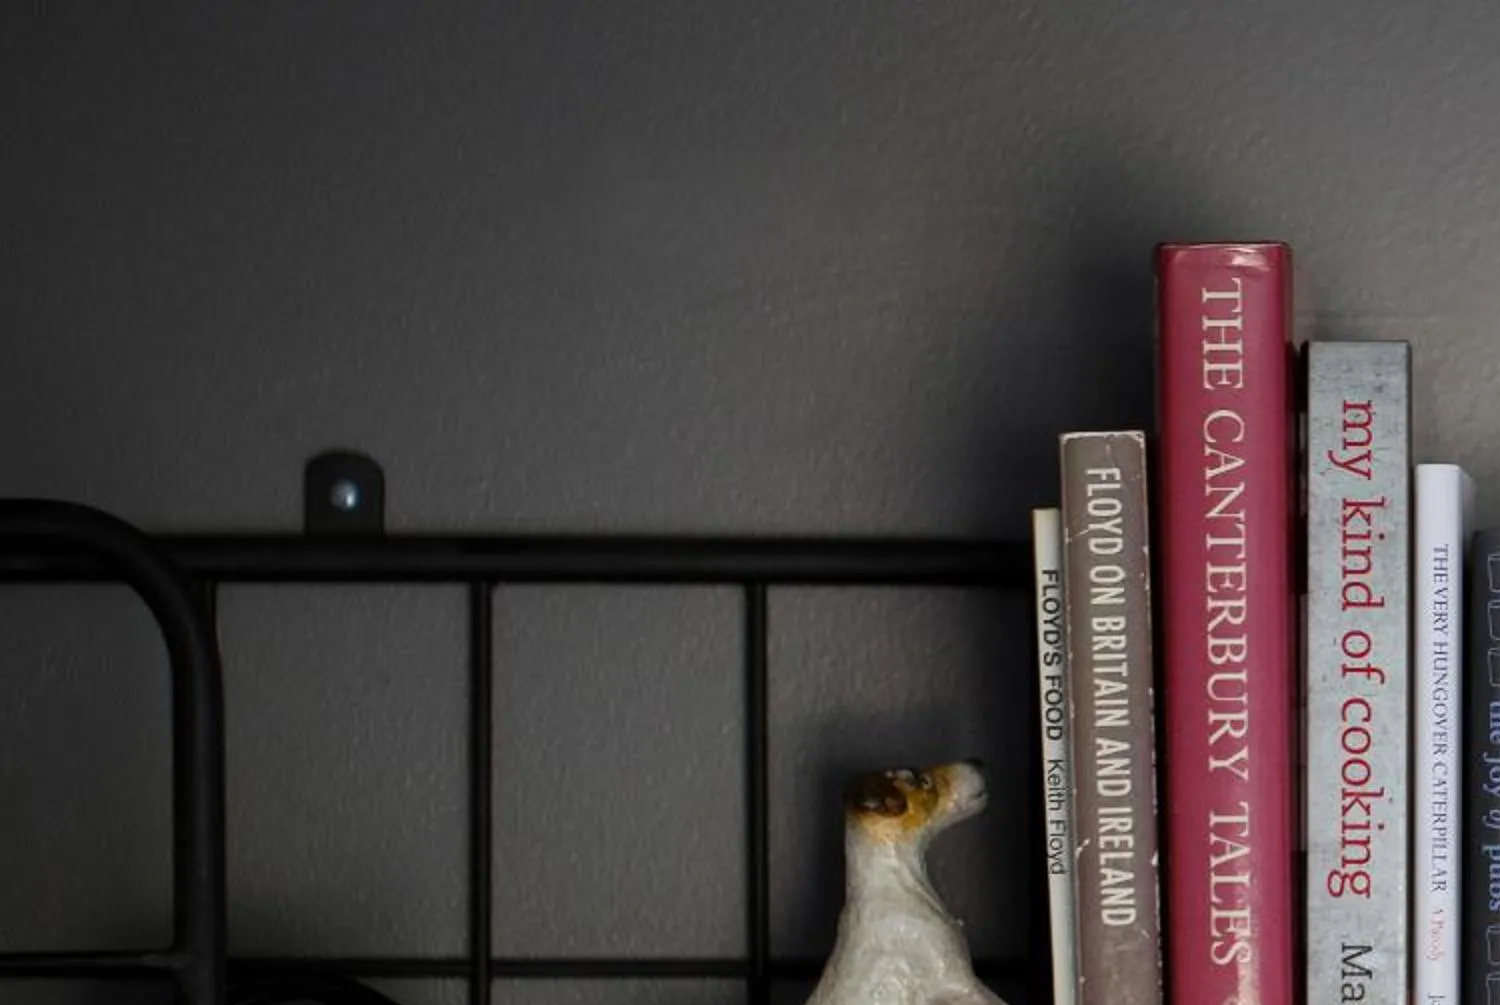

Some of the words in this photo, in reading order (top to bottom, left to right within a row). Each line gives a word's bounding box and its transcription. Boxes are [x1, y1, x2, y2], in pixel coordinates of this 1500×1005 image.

[1202, 278, 1243, 390] THE
[1328, 400, 1376, 482] my
[1086, 467, 1123, 555] FLOYD
[1342, 497, 1386, 612] kind
[1089, 565, 1126, 605] ON
[1204, 409, 1249, 781] CANTERBURY
[1433, 544, 1449, 582] THE
[1042, 570, 1061, 667] FLOYD'S
[1433, 588, 1449, 636] VERY
[1091, 616, 1130, 726] BRITAIN
[1341, 631, 1386, 686] of
[1432, 642, 1449, 756] HUNGOVER
[1045, 676, 1063, 741] FOOD
[1046, 759, 1066, 811] Keith
[1095, 737, 1133, 797] AND
[1328, 698, 1387, 899] cooking
[1047, 820, 1068, 875] Floyd
[1098, 807, 1137, 926] IRELAND
[1431, 763, 1447, 893] CATERPILLAR
[1209, 801, 1252, 967] TALES
